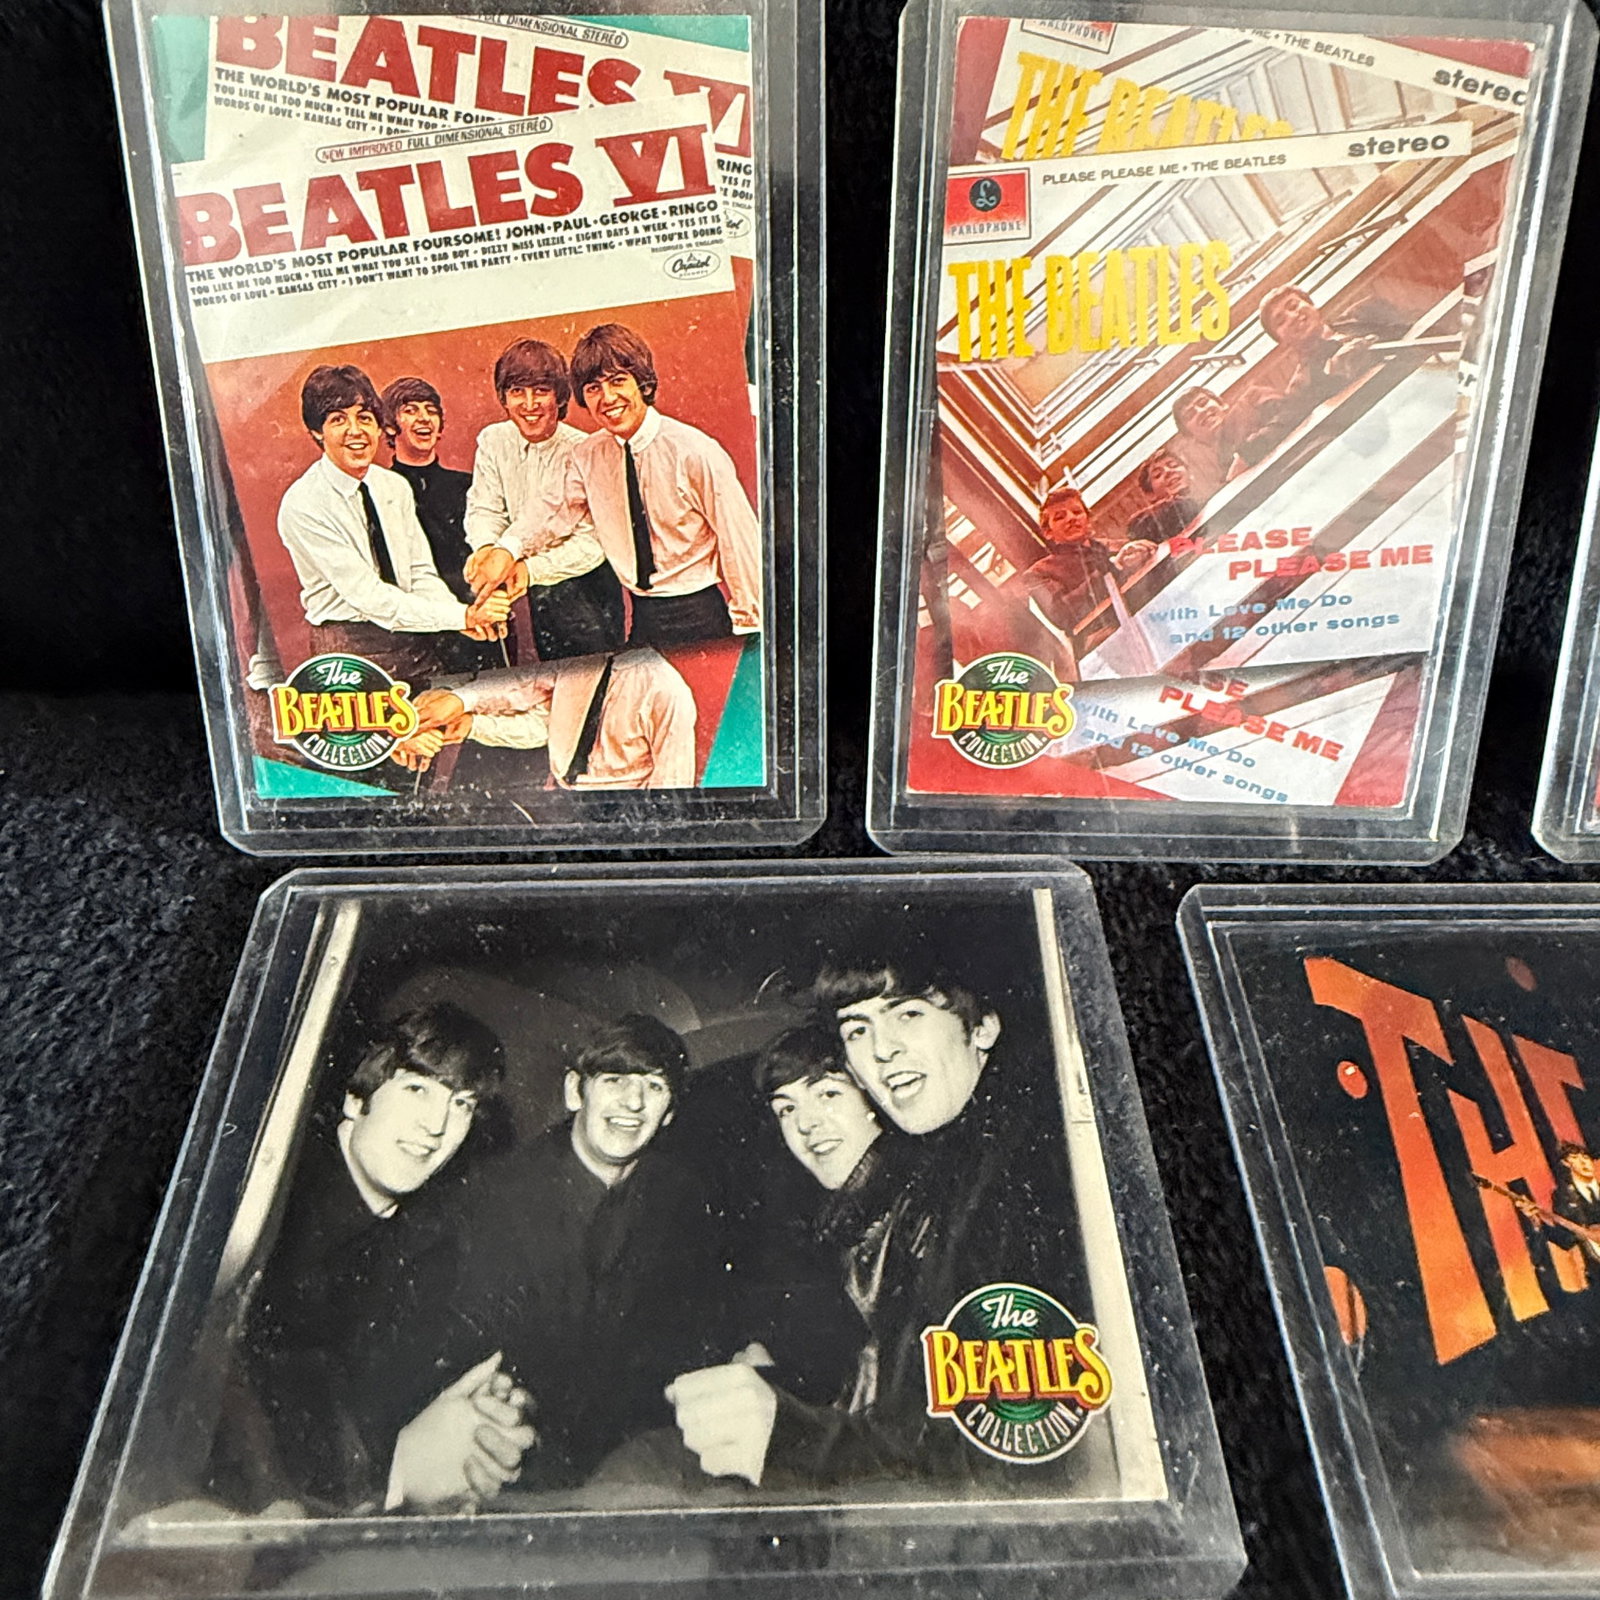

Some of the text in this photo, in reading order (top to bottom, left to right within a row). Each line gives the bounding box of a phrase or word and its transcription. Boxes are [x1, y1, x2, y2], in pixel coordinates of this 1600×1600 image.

[506, 14, 578, 39] DIMENSIONAL
[582, 29, 623, 46] STEREO
[1284, 33, 1311, 50] THE
[1314, 41, 1376, 67] BEATLES
[216, 15, 641, 116] BEATLES
[214, 83, 235, 96] YOU
[239, 88, 260, 100] LIKE
[264, 92, 278, 104] ME
[282, 95, 302, 108] TOO
[305, 99, 333, 113] MUCH
[344, 106, 366, 119] TELL
[369, 111, 383, 122] ME
[387, 114, 413, 127] WHAT
[214, 96, 250, 112] WORDS
[253, 103, 265, 113] OF
[269, 106, 292, 119] LOVE
[304, 112, 342, 128] KANSAS
[346, 120, 368, 132] CITY
[215, 67, 245, 84] THE
[250, 73, 321, 98] WORLD'S
[327, 88, 371, 106] MOST
[376, 96, 449, 121] POPULAR
[1000, 51, 1104, 161] THE
[322, 148, 345, 160] NEW
[349, 140, 402, 156] IMPROVED
[407, 137, 431, 149] FULL
[434, 126, 504, 145] DIMENSIONAL
[508, 119, 547, 135] STEREO
[1042, 134, 1450, 185] PLEASE PLEASE ME THE BEATLES stereo
[176, 124, 715, 266] BEATLES VI
[742, 178, 751, 189] IT
[186, 269, 216, 283] THE
[218, 258, 287, 279] WORLD'S
[292, 252, 333, 269] MOST
[338, 242, 409, 262] POPULAR
[413, 228, 501, 252] FOURSOME!
[506, 223, 546, 240] JOHN
[552, 217, 592, 233] PAUL
[599, 207, 660, 226] GEORGE
[668, 199, 719, 218] RINGO
[950, 219, 1022, 237] PARLOPHONE
[190, 285, 210, 296] YOU
[213, 281, 234, 293] LIKE
[236, 279, 251, 290] ME
[253, 276, 272, 287] TOO
[275, 271, 303, 284] MUCH
[311, 268, 333, 279] TELL
[335, 265, 350, 276] ME
[352, 261, 379, 273] WHAT
[381, 258, 402, 269] YOU
[405, 255, 421, 266] SEE
[452, 249, 470, 260] BOY
[481, 243, 508, 256] DIZZY
[511, 239, 535, 252] MISS
[537, 235, 566, 248] LIZZIE
[575, 230, 603, 243] EIGHT
[607, 225, 630, 238] DAYS
[633, 225, 640, 235] A
[642, 221, 669, 233] WEEK
[678, 217, 696, 229] YES
[700, 215, 708, 226] IT
[711, 213, 721, 224] IS
[193, 294, 228, 308] WORDS
[230, 291, 242, 303] OF
[244, 288, 268, 301] LOVE
[277, 282, 314, 296] KANSAS
[317, 278, 338, 290] CITY
[355, 272, 384, 285] DON'T
[386, 268, 413, 281] WANT
[416, 266, 429, 277] TO
[431, 262, 459, 275] SPOIL
[461, 259, 479, 270] THE
[482, 254, 511, 268] PARTY
[521, 249, 551, 262] EVERY
[585, 240, 616, 253] THING
[625, 235, 652, 248] WHAT
[654, 230, 690, 244] YOU'RE
[692, 226, 723, 239] DOING
[671, 255, 712, 274] Capitol
[947, 240, 1231, 362] THE BEATLES
[1229, 544, 1434, 580] PLEASE ME
[1149, 593, 1353, 622] with Love Me Do
[1169, 613, 1401, 645] and 12 other songs
[315, 660, 363, 686] The
[986, 660, 1030, 685] The
[275, 684, 417, 737] BEATLES
[938, 682, 1076, 737] BEATLES
[1158, 685, 1290, 743] PLEASE
[1291, 731, 1344, 762] ME
[302, 732, 389, 765] COLLECTION
[960, 731, 1048, 763] COLLECTION
[1127, 716, 1181, 743] Love
[1187, 736, 1220, 756] Me
[1226, 748, 1256, 769] Do
[1130, 741, 1155, 757] 12
[1160, 754, 1218, 779] other
[1222, 773, 1289, 803] songs
[981, 1293, 1040, 1329] The
[927, 1327, 1112, 1407] BEATLES
[965, 1400, 1080, 1455] COLLECTION
